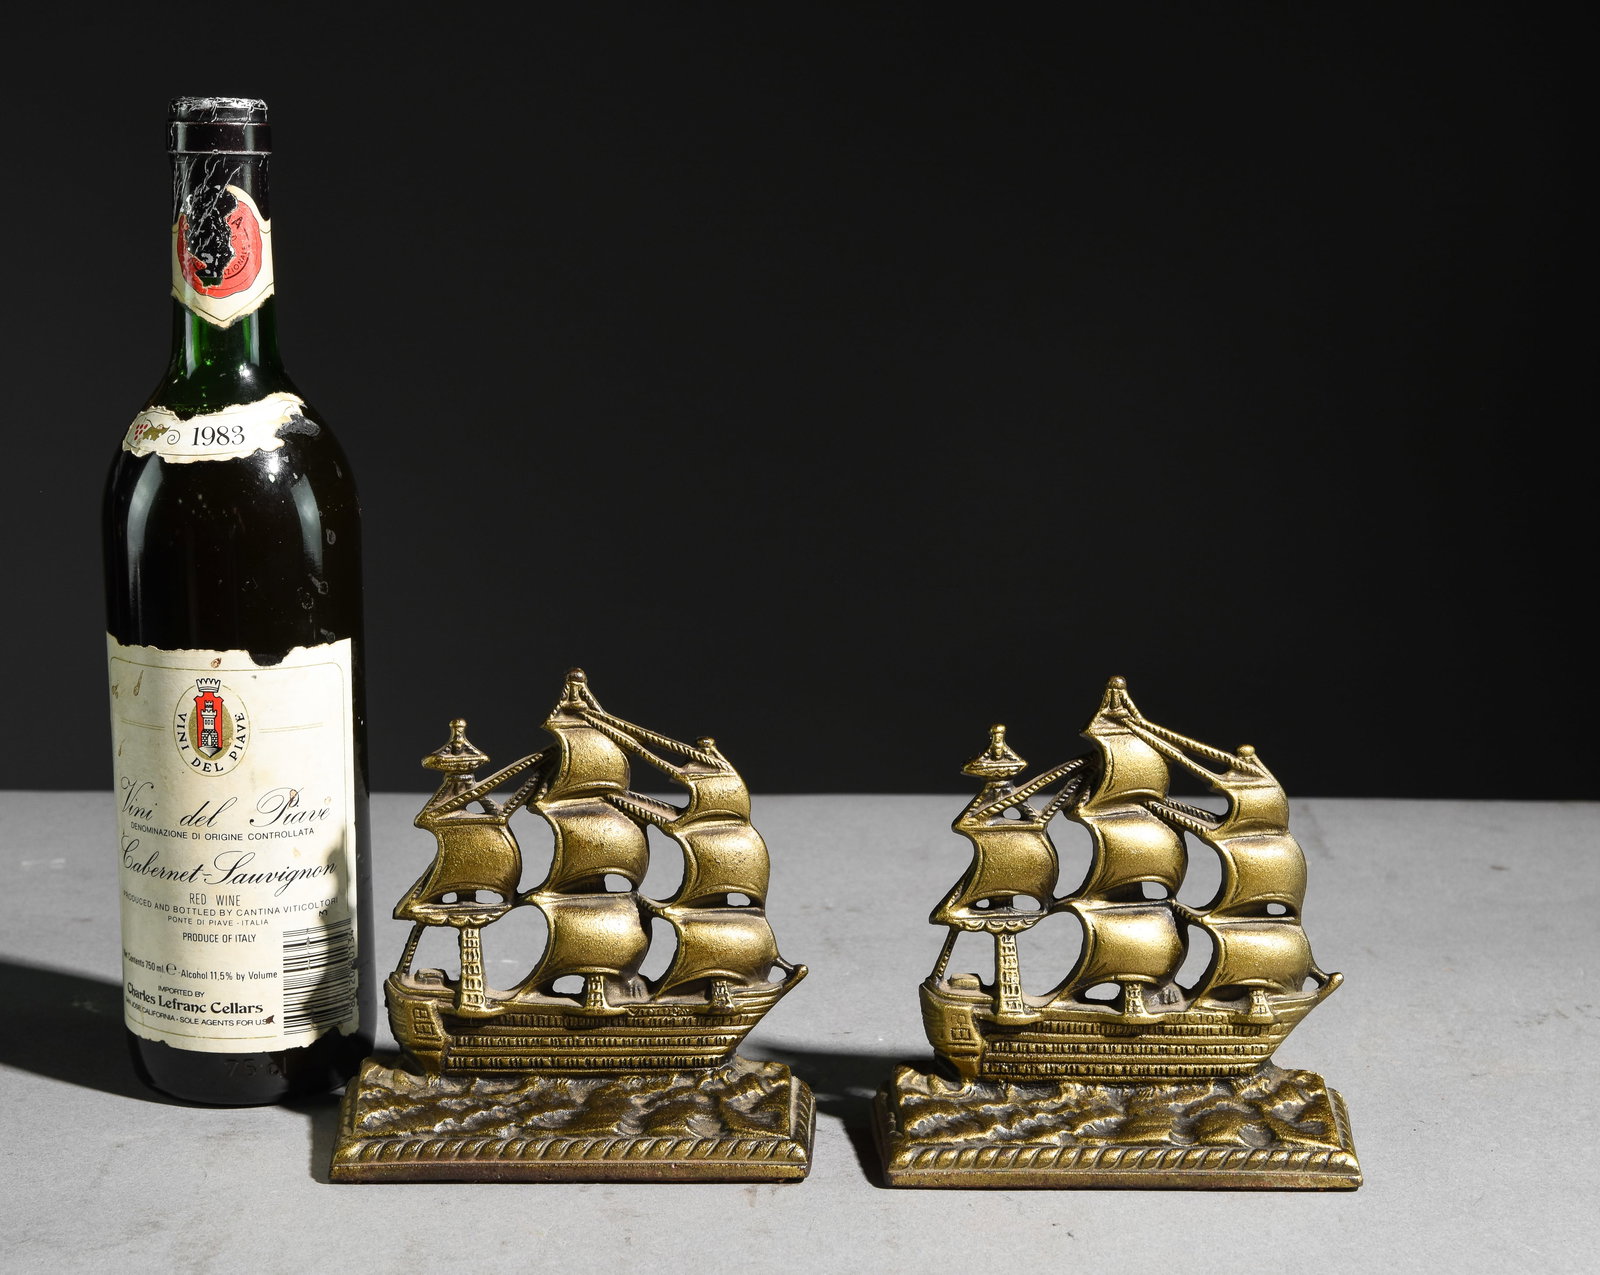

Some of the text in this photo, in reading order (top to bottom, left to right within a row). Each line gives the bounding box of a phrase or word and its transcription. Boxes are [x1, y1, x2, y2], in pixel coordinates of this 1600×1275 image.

[192, 425, 245, 447] 1983
[177, 712, 247, 773] VINI DEL PIAVE
[120, 776, 157, 821] Vini
[179, 797, 238, 827] del
[130, 821, 315, 841] DENOMINAZIONE DI ORIGINE CONTROLLATA
[189, 892, 241, 907] RED WINE
[154, 903, 170, 912] AND
[173, 905, 216, 917] BOTTLED
[219, 908, 233, 917] BY
[236, 907, 280, 917] CANTINA
[167, 915, 193, 925] PONTE
[208, 919, 233, 927] PIAVE
[182, 932, 256, 944] PRODUCE OF ITALY
[145, 960, 156, 971] 750
[236, 971, 245, 982] by
[248, 971, 278, 980] Volume
[127, 982, 264, 1014] Charles Lefranc Cellars
[158, 985, 193, 997] IMPORTED
[179, 1016, 199, 1025] SOLE
[201, 1018, 234, 1027] AGENTS
[236, 1019, 253, 1027] FOR
